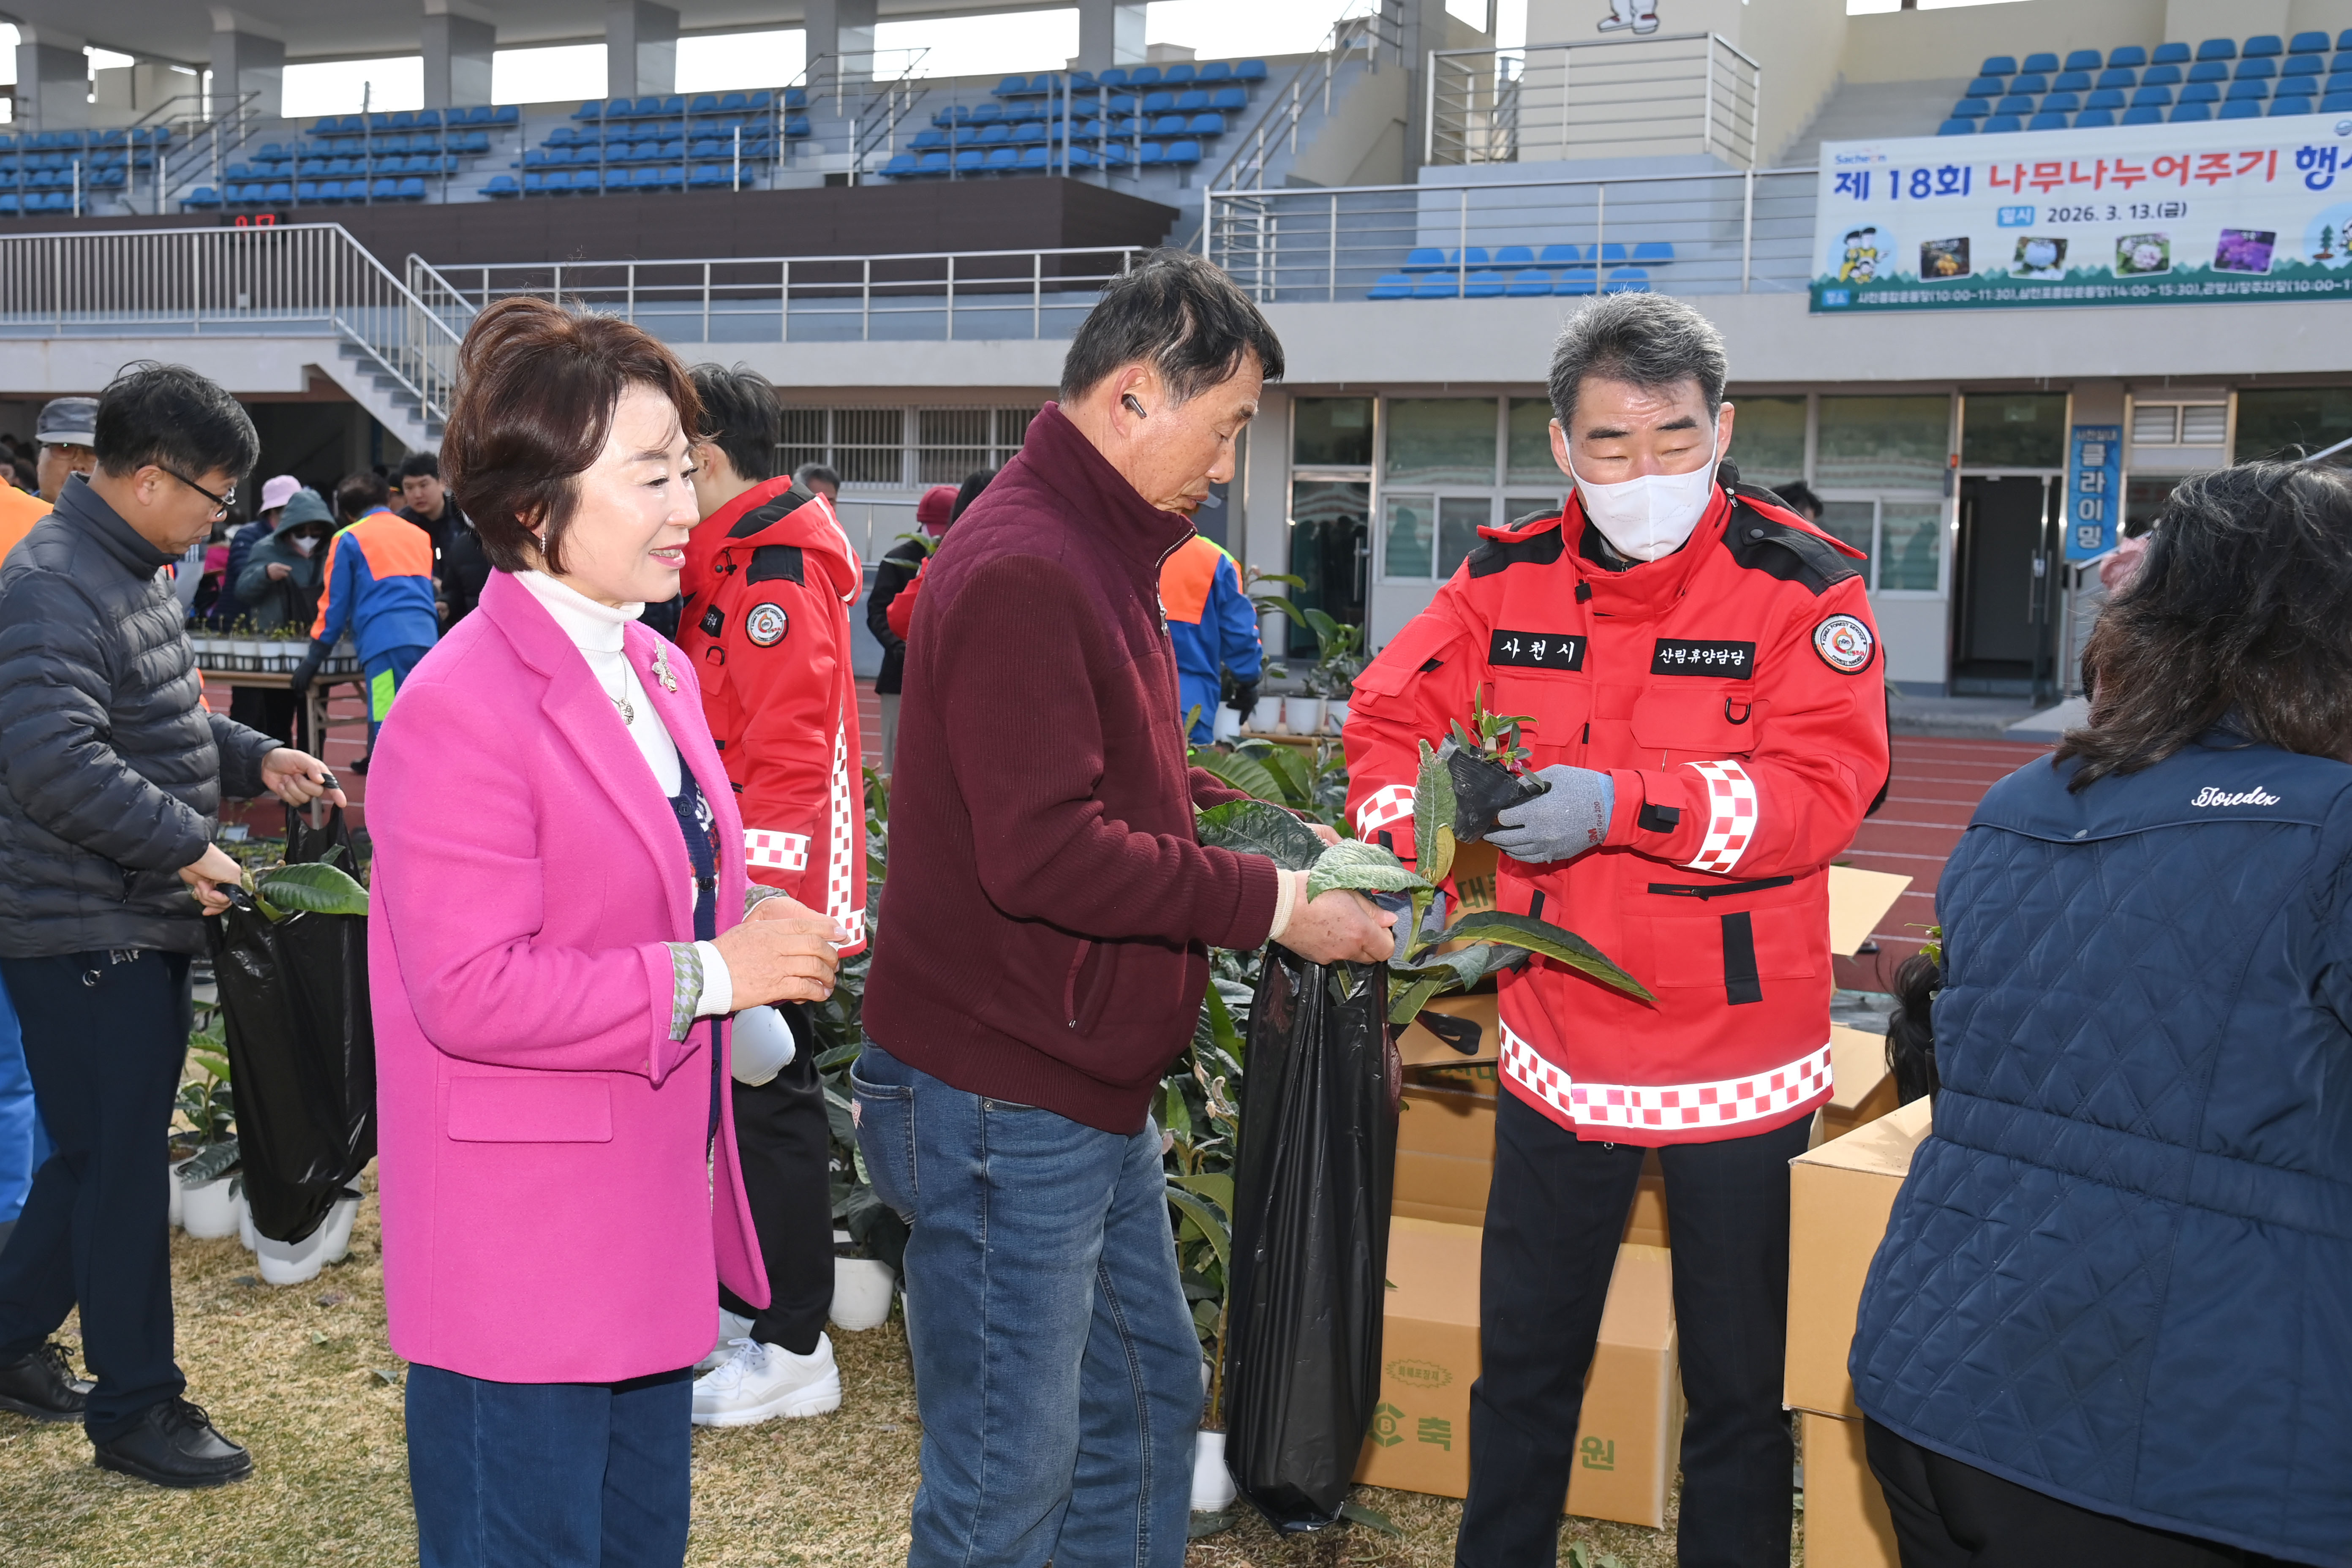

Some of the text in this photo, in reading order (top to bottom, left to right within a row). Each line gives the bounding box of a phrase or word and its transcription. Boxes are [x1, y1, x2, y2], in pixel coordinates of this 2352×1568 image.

[1834, 145, 2352, 200] 제 18회 나무나누어주기 행
[2001, 207, 2031, 224] 일시
[2047, 206, 2099, 223] 2026.
[2106, 204, 2121, 221] 3.
[2077, 444, 2107, 549] 클라이밍
[1850, 625, 1865, 640] SERVICE
[1658, 648, 1745, 666] 산림휴양담당
[1587, 828, 1598, 843] 3M
[1580, 1436, 1614, 1471] 원
